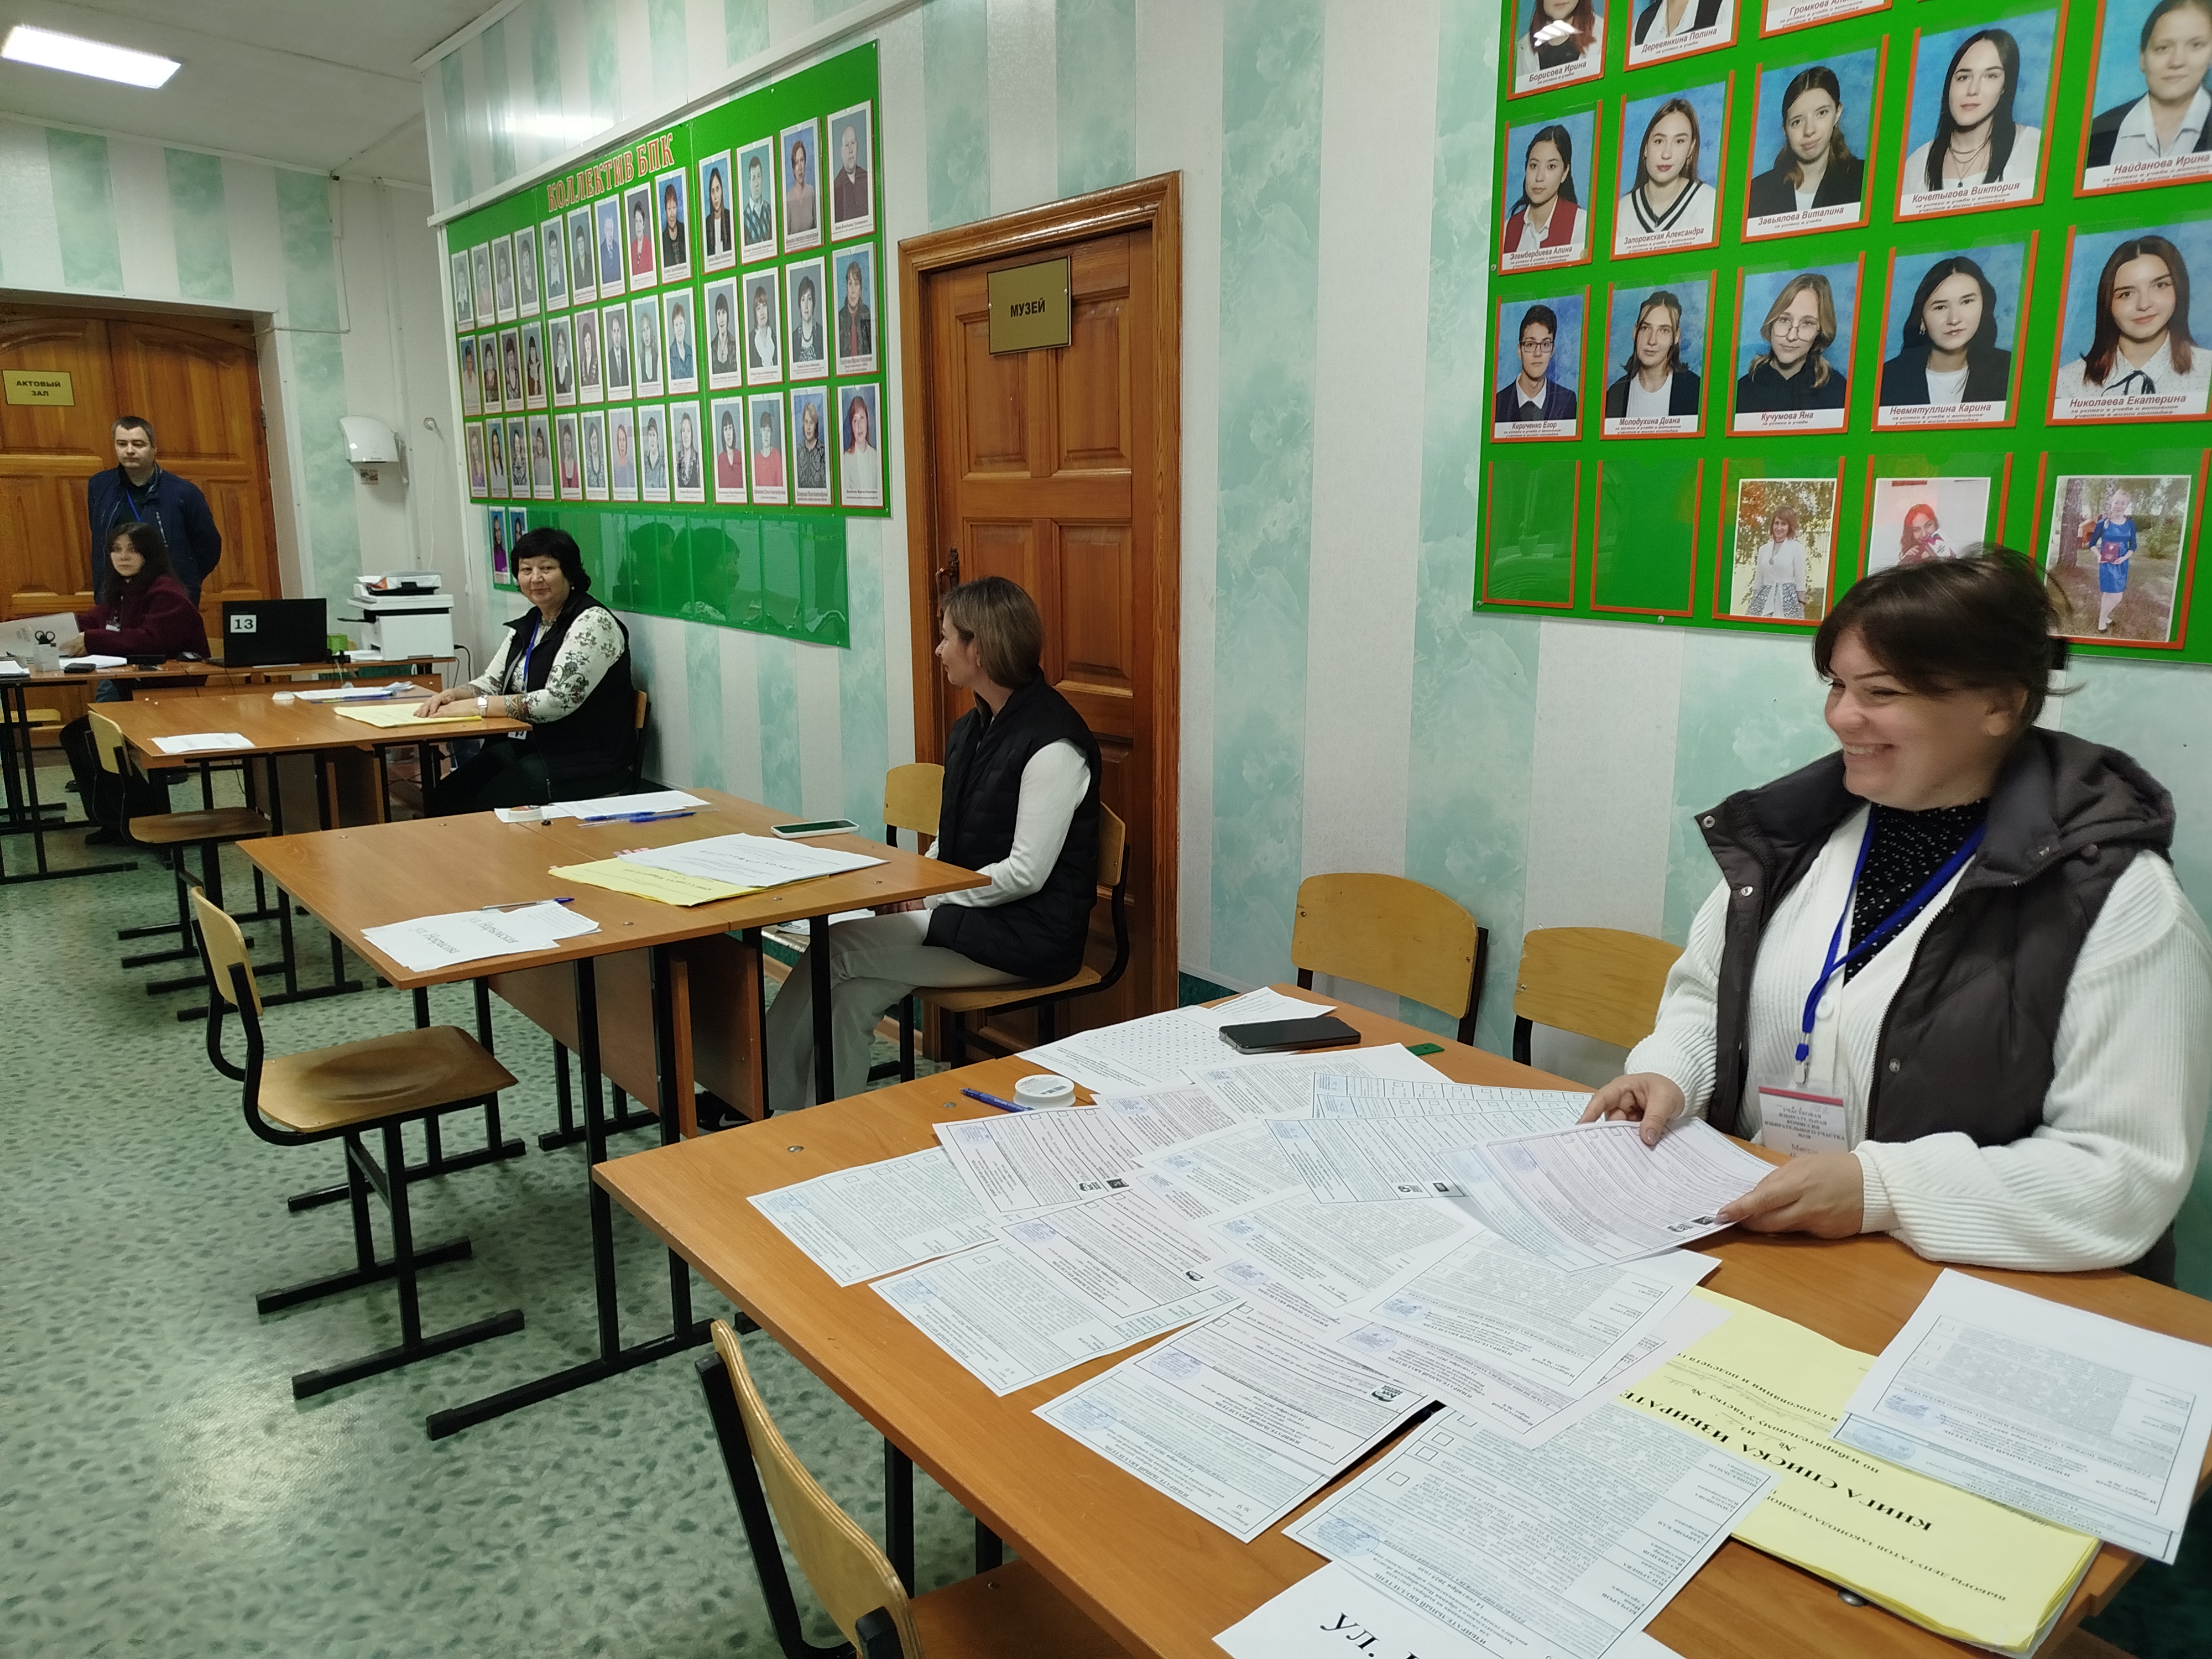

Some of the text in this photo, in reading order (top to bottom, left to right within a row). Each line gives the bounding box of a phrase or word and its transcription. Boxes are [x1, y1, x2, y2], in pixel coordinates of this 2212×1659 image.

[1790, 1, 1829, 15] Громкова
[1641, 35, 1687, 54] Деревянкина
[1689, 28, 1717, 40] Полина
[1529, 67, 1562, 82] Борисова
[1564, 61, 1587, 73] Ирина
[547, 132, 675, 213] КОЛЛЕКТИВ БПК
[2114, 154, 2210, 175] Найданова Ирина
[1912, 182, 2020, 203] Кочетыгова Виктория
[1758, 207, 1844, 226] Завьялова Виталина
[1624, 227, 1704, 244] Запорожская Александра
[1010, 297, 1045, 317] МУЗЕЙ
[1890, 404, 1991, 415] Невмятуллина Карина
[2069, 395, 2187, 408] Николаева Екатерина
[1619, 416, 1681, 427] Молодухина Диана
[1761, 413, 1797, 422] Кучумова
[234, 619, 253, 629] 13
[1689, 1357, 1739, 1379] подсчета
[1692, 1388, 1705, 1396] №
[1752, 1383, 1827, 1418] голосования
[1710, 1395, 1755, 1421] участку
[1740, 1427, 1756, 1436] из
[1759, 1421, 1859, 1464] избирательному
[1626, 1392, 1931, 1531] КНИГА СПИСКА ИЗБИРАТЕ
[1863, 1464, 1879, 1473] по
[1767, 1496, 2006, 1601] ВЫБОРЫ ДЕПУТАТОВ ЗАКОНОДАТЕЛЬНОГ
[1372, 1573, 1486, 1644] ИЗБИРАТЕЛЬНЫЙ БЮЛЛЕТЕНЬ
[1319, 1611, 1380, 1657] ул.
